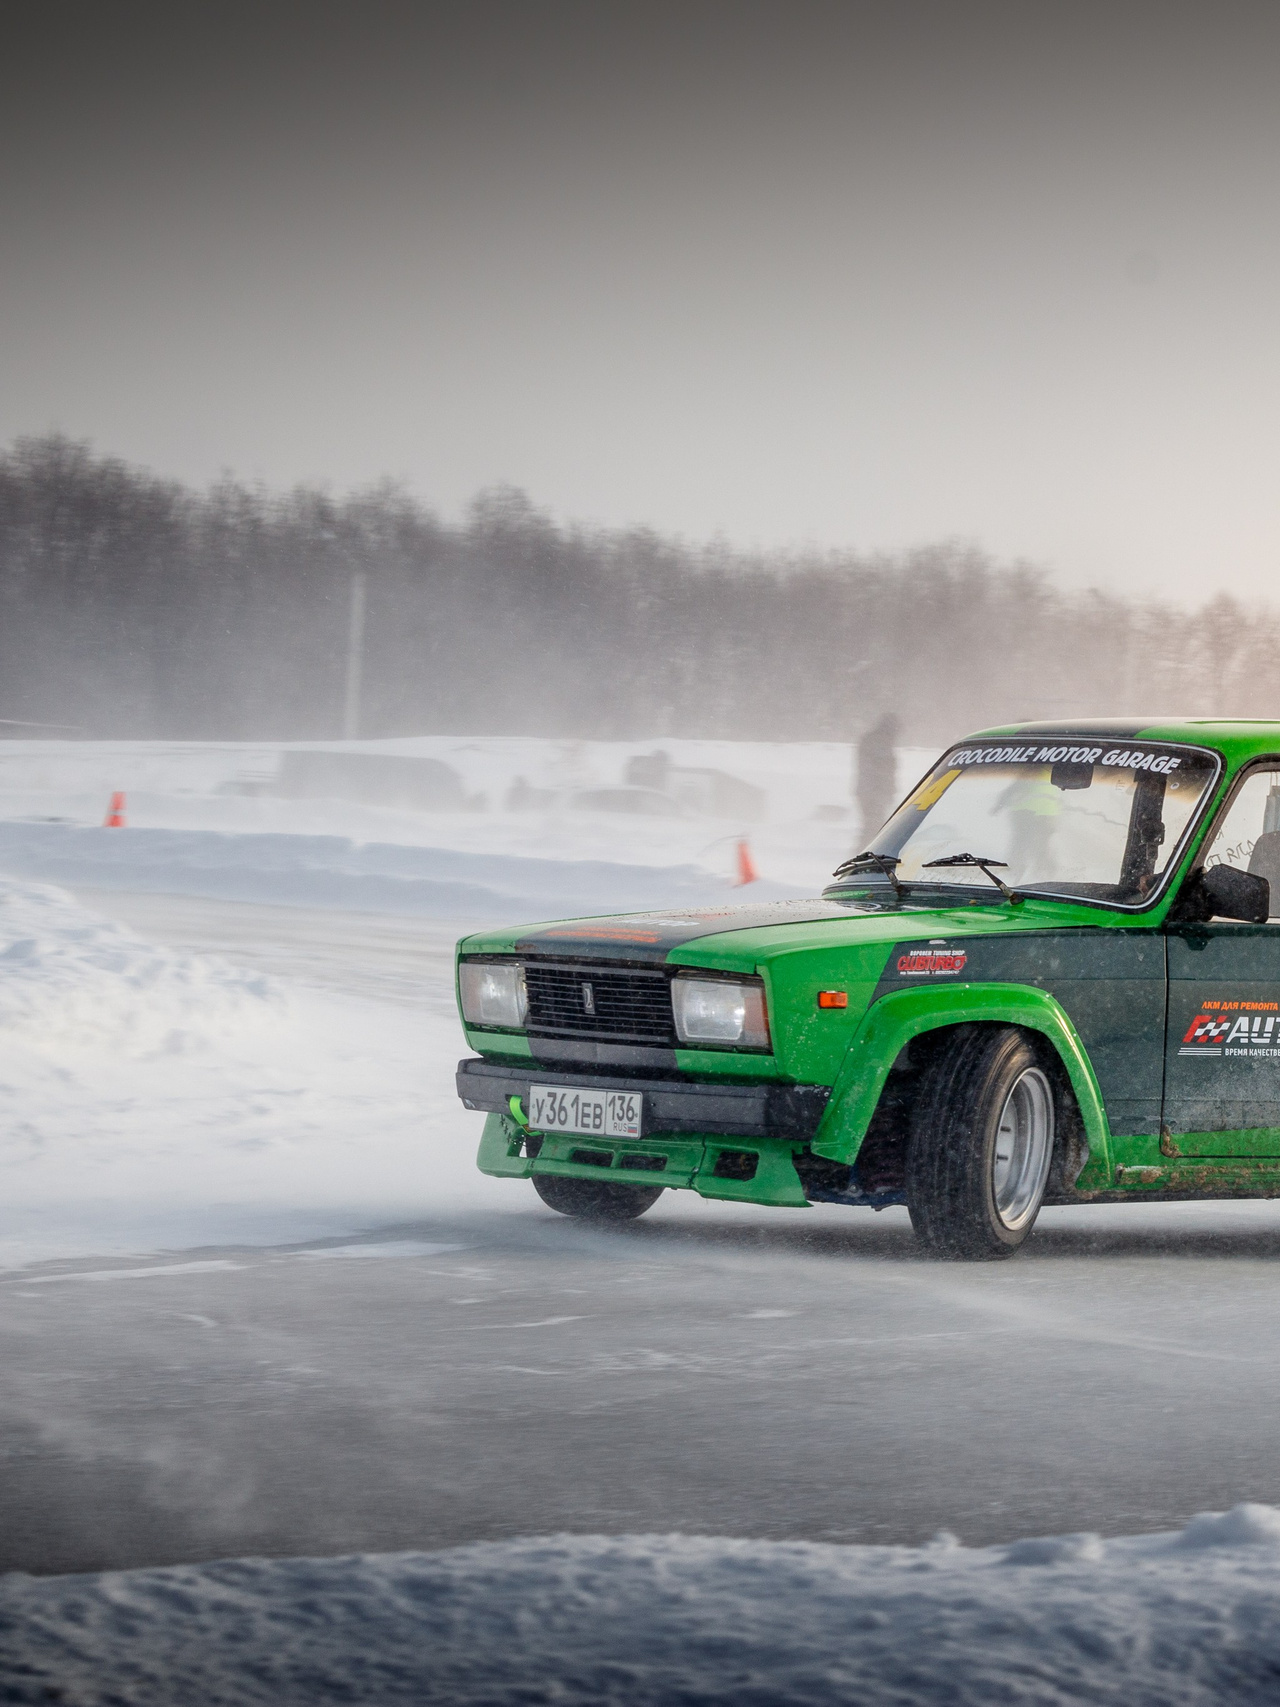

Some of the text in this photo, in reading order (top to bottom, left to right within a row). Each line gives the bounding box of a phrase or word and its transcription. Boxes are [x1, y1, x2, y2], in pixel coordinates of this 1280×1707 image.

[947, 747, 1182, 775] CROCODILE MOTOR GARAGE
[1201, 1001, 1221, 1010] ЛКМ
[1220, 1001, 1239, 1011] ДЛЯ
[1240, 1002, 1278, 1011] РЕМОНТА
[1224, 1048, 1248, 1056] ВРЕМЯ
[608, 1095, 635, 1122] 136
[612, 1122, 628, 1133] RUS
